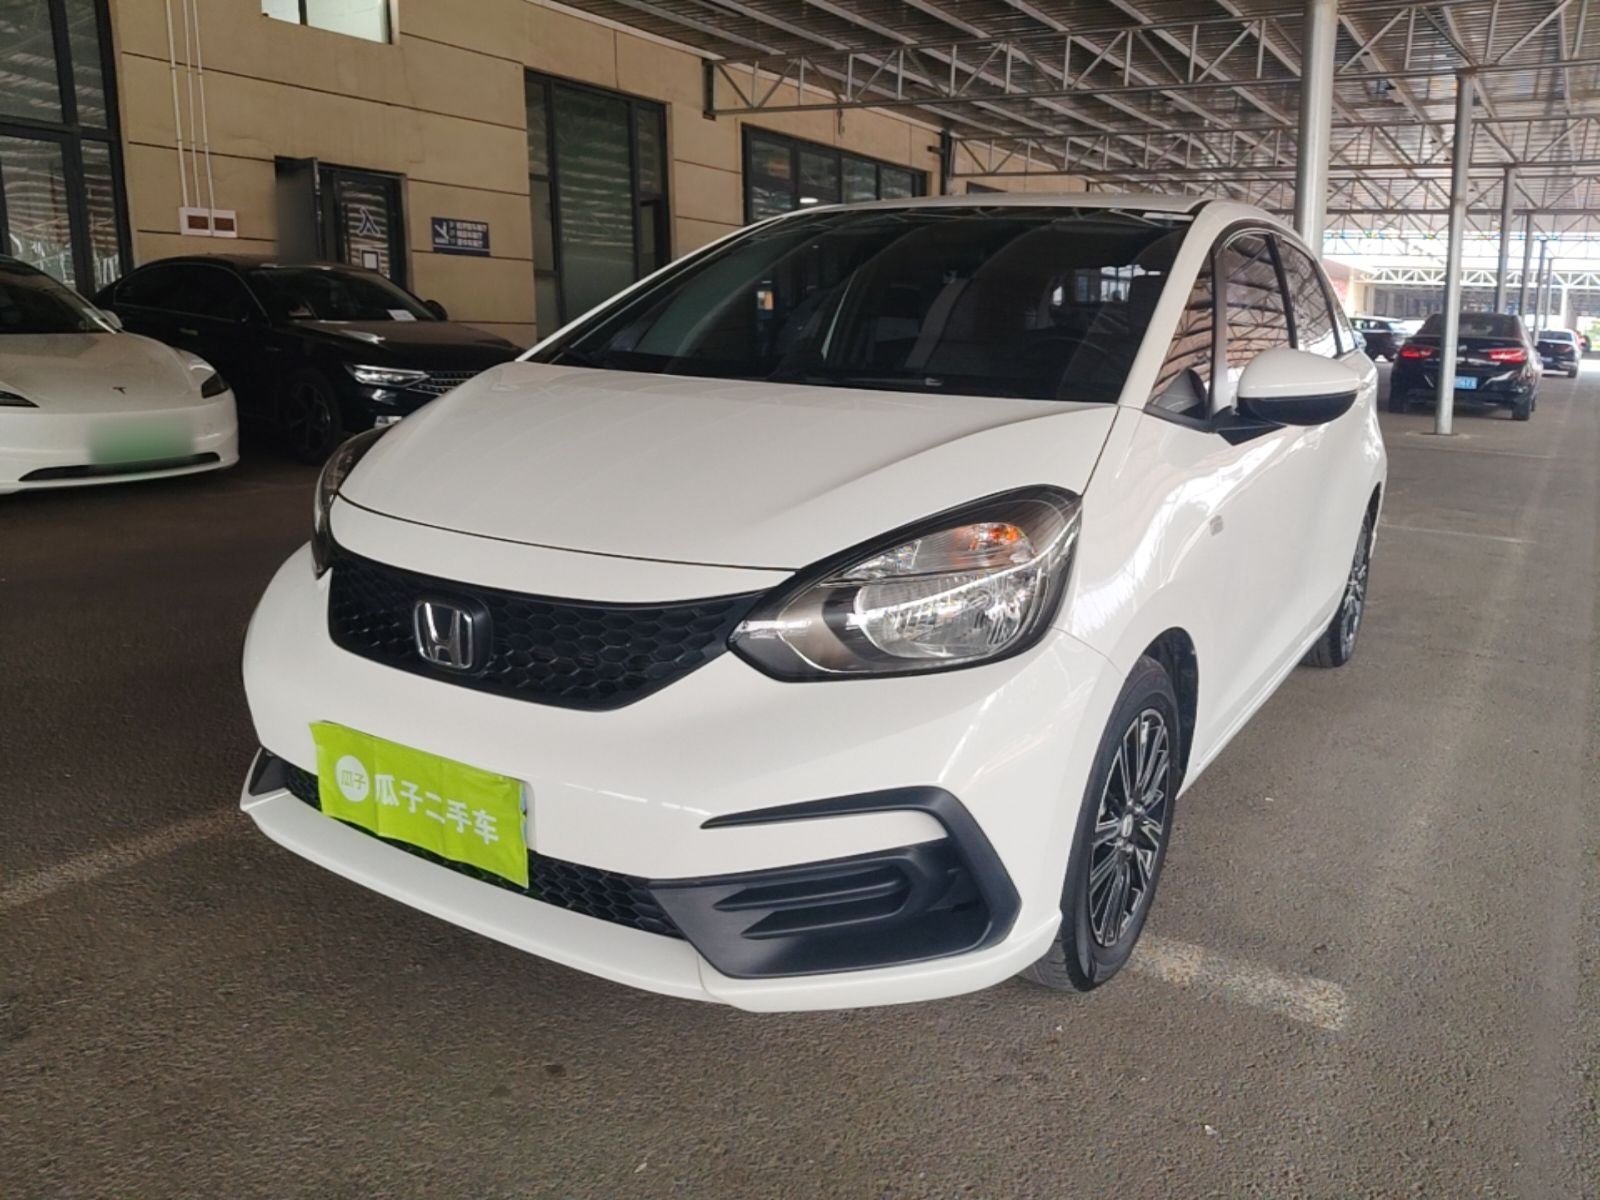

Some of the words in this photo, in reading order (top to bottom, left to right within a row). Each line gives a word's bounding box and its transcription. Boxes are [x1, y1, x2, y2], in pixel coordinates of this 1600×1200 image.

[341, 770, 367, 790] 瓜子
[374, 774, 499, 845] 瓜子二手车
